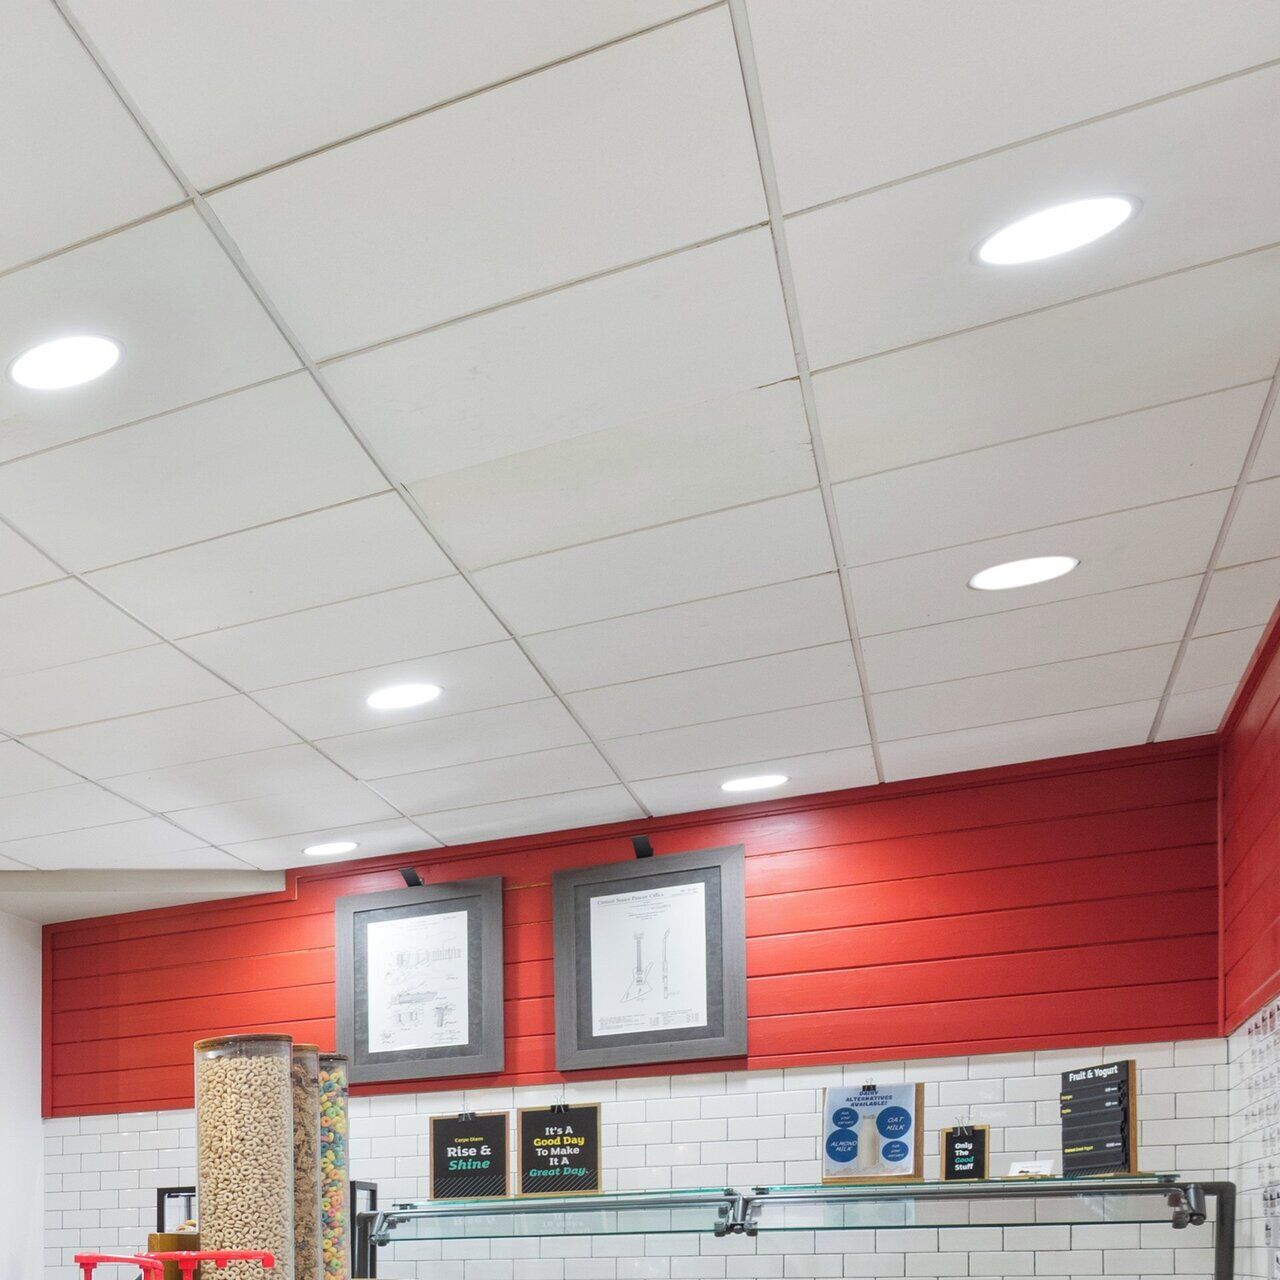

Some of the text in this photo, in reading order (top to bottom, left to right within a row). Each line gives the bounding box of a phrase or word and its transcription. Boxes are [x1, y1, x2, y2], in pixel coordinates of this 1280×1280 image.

[1069, 1065, 1118, 1082] Fruit & Yogurt
[545, 1125, 573, 1136] It's A
[533, 1136, 585, 1147] Good Day
[446, 1145, 491, 1157] Rise &
[535, 1146, 580, 1156] To Make
[448, 1159, 490, 1171] Shine
[549, 1157, 569, 1166] It A
[955, 1163, 974, 1171] Stuff
[529, 1168, 560, 1177] Great
